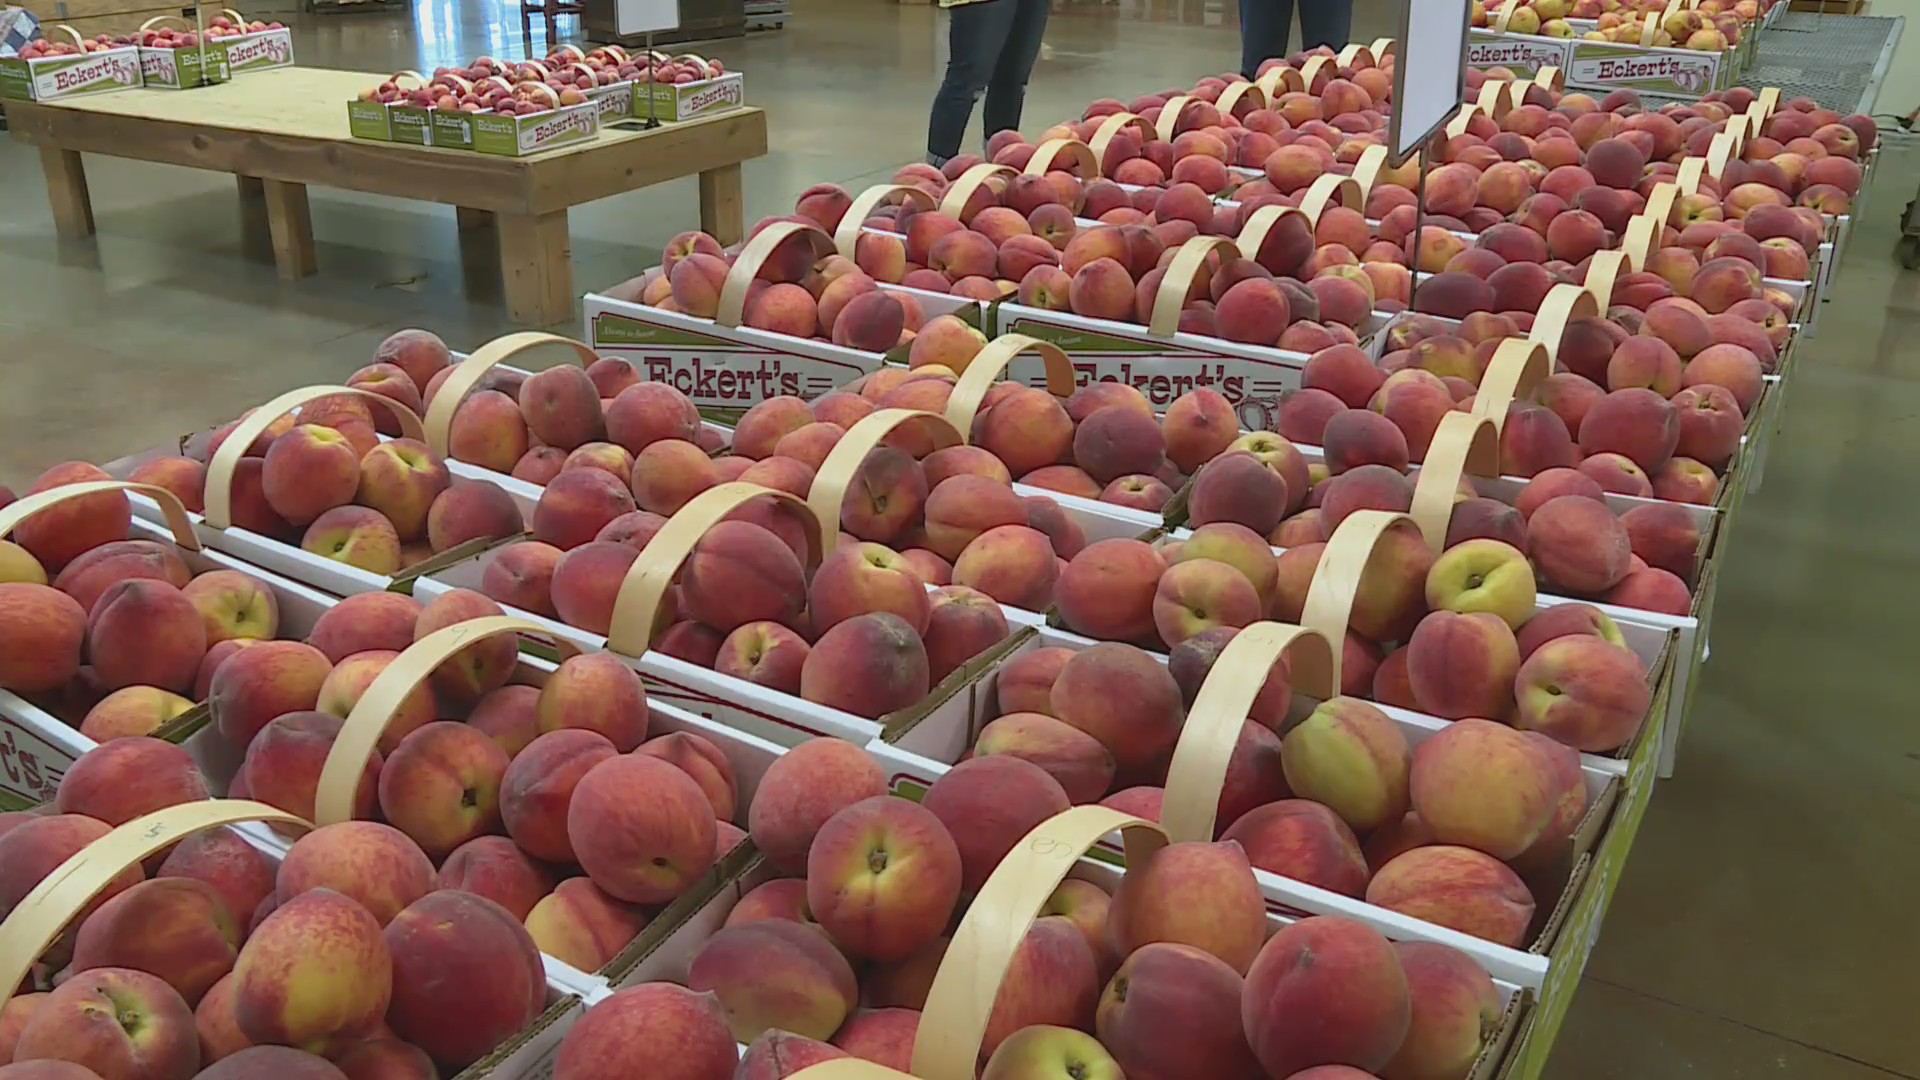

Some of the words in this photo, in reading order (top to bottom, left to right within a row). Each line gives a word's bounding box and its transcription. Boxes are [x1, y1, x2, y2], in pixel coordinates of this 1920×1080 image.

[229, 37, 275, 64] ckert's
[1467, 44, 1532, 62] ckert's
[54, 57, 120, 90] Eckert's
[1597, 57, 1680, 79] Eckert's
[691, 84, 727, 111] Eckert's
[535, 112, 579, 142] Eckert's
[643, 356, 800, 400] Eckert's
